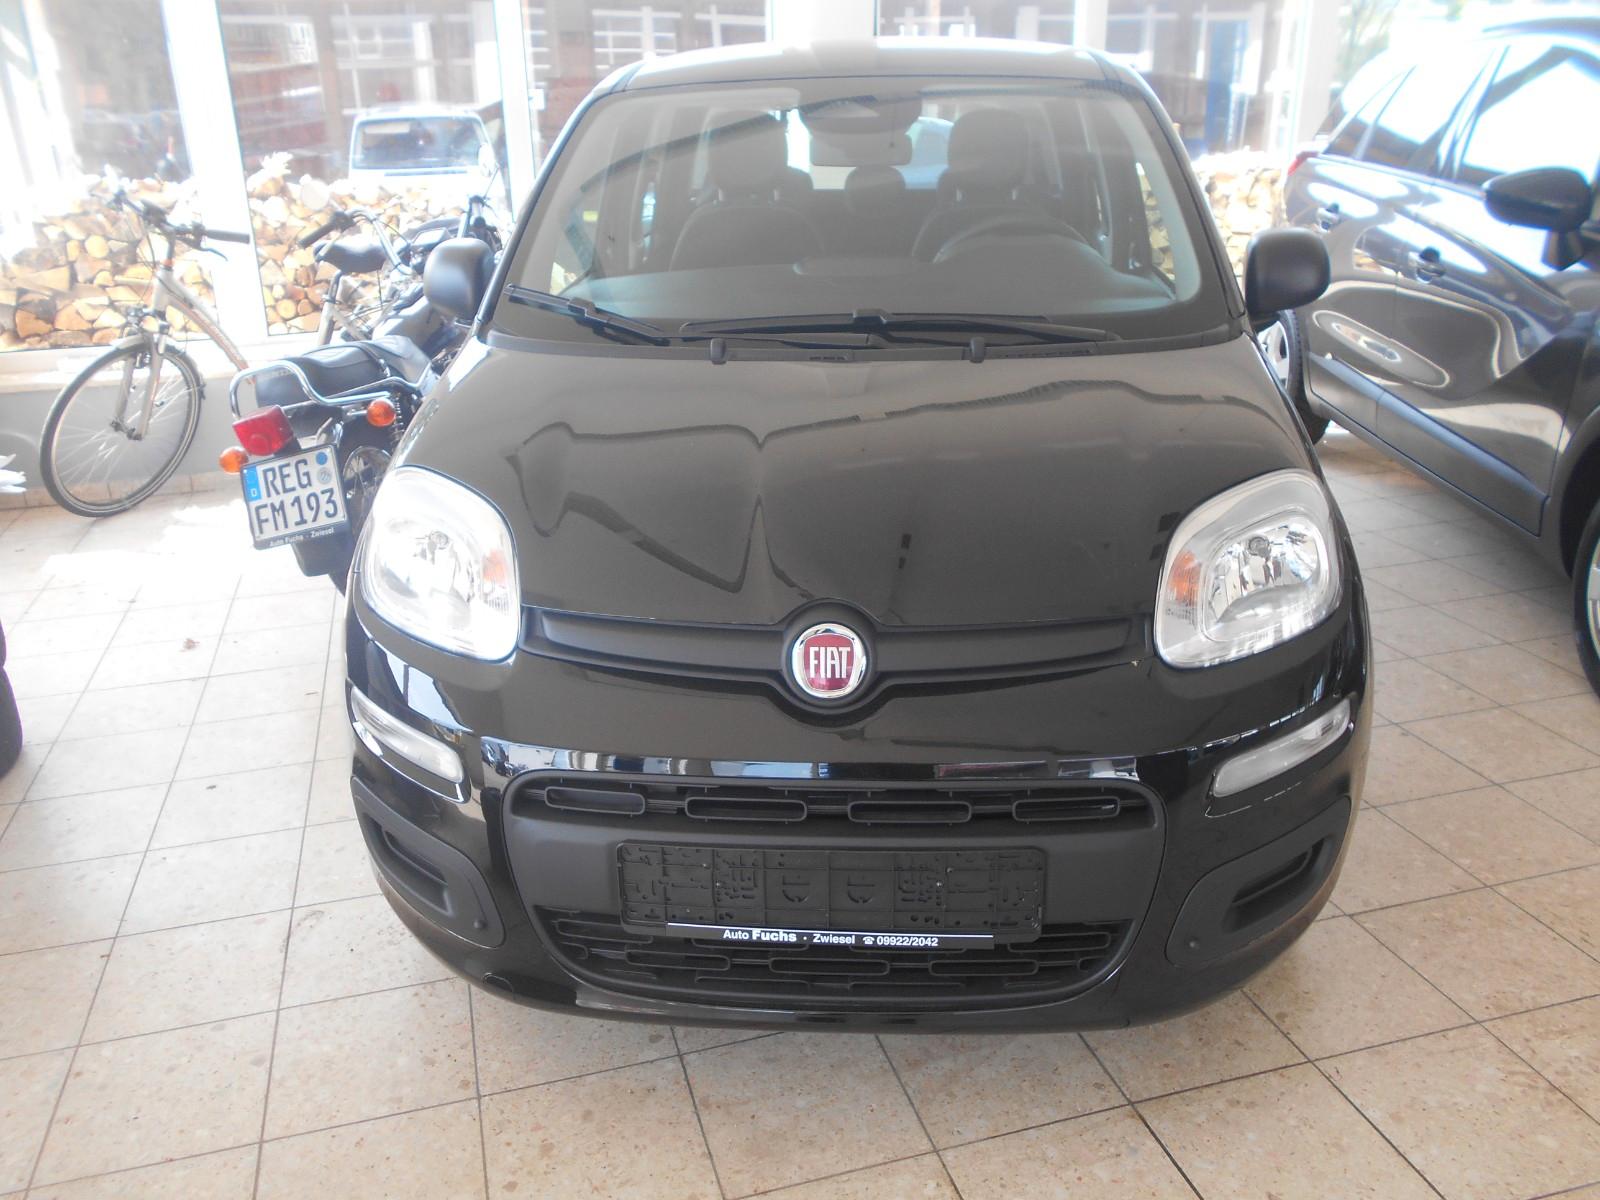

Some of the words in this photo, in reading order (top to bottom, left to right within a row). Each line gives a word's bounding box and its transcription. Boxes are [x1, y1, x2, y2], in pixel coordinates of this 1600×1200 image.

[262, 458, 313, 498] REG
[809, 646, 851, 679] FIAT
[723, 929, 750, 941] Auto
[752, 929, 797, 942] Fuchs
[813, 933, 856, 945] Zwiesel
[876, 935, 939, 947] 09922/2042
